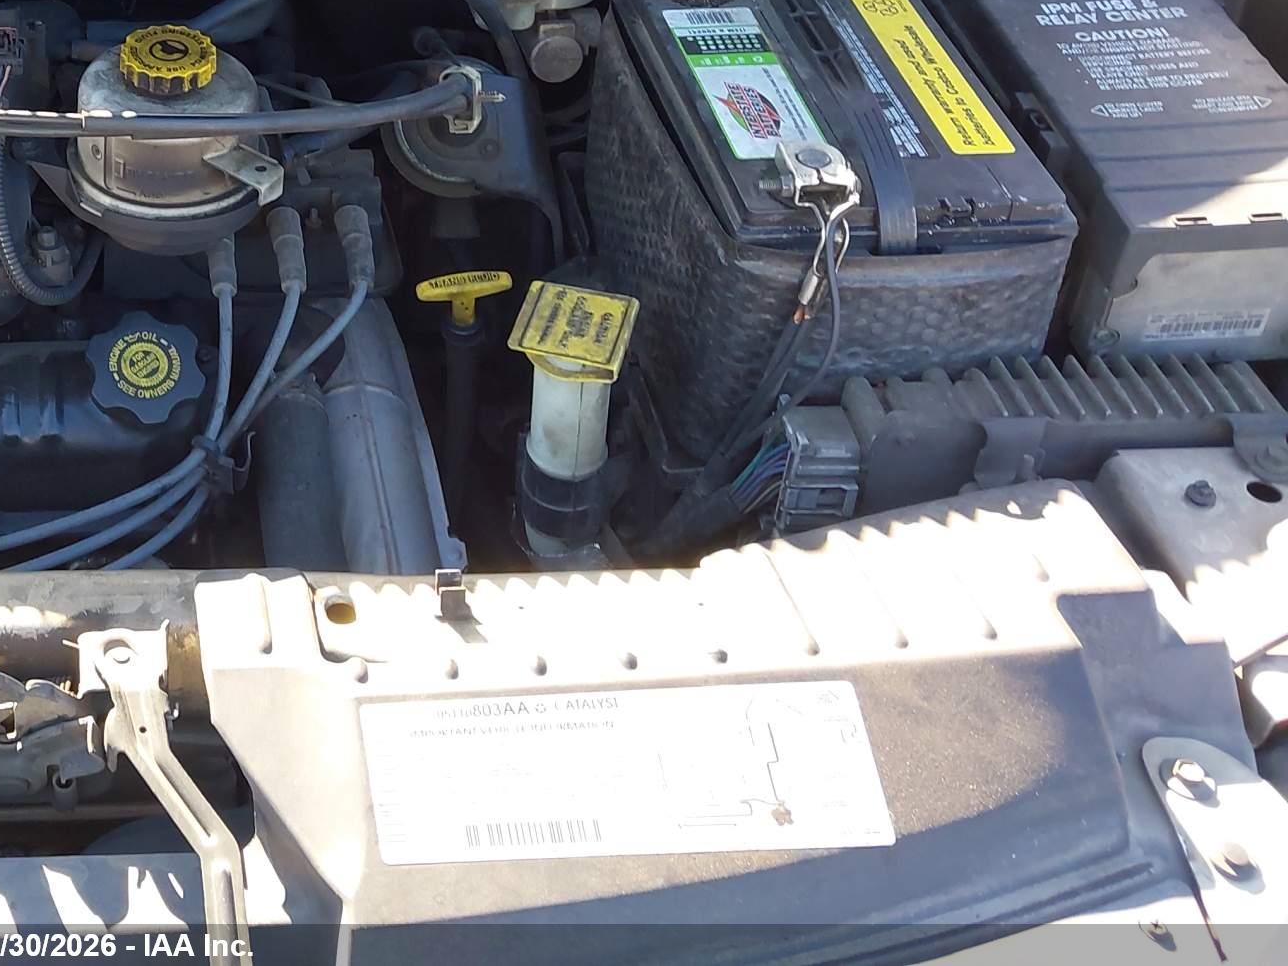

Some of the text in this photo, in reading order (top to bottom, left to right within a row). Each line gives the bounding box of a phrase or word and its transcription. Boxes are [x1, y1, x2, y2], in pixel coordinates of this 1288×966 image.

[1035, 6, 1189, 26] RELAY CENTER
[1040, 1, 1083, 15] IPM
[903, 24, 938, 65] Wholesale
[1074, 26, 1171, 42] CAUTION!
[934, 65, 959, 96] Costco
[727, 83, 767, 139] INTERSTATE
[744, 86, 780, 138] BATTERIES
[108, 338, 128, 372] ENGINE
[141, 331, 160, 343] OIL
[118, 379, 137, 396] SEE
